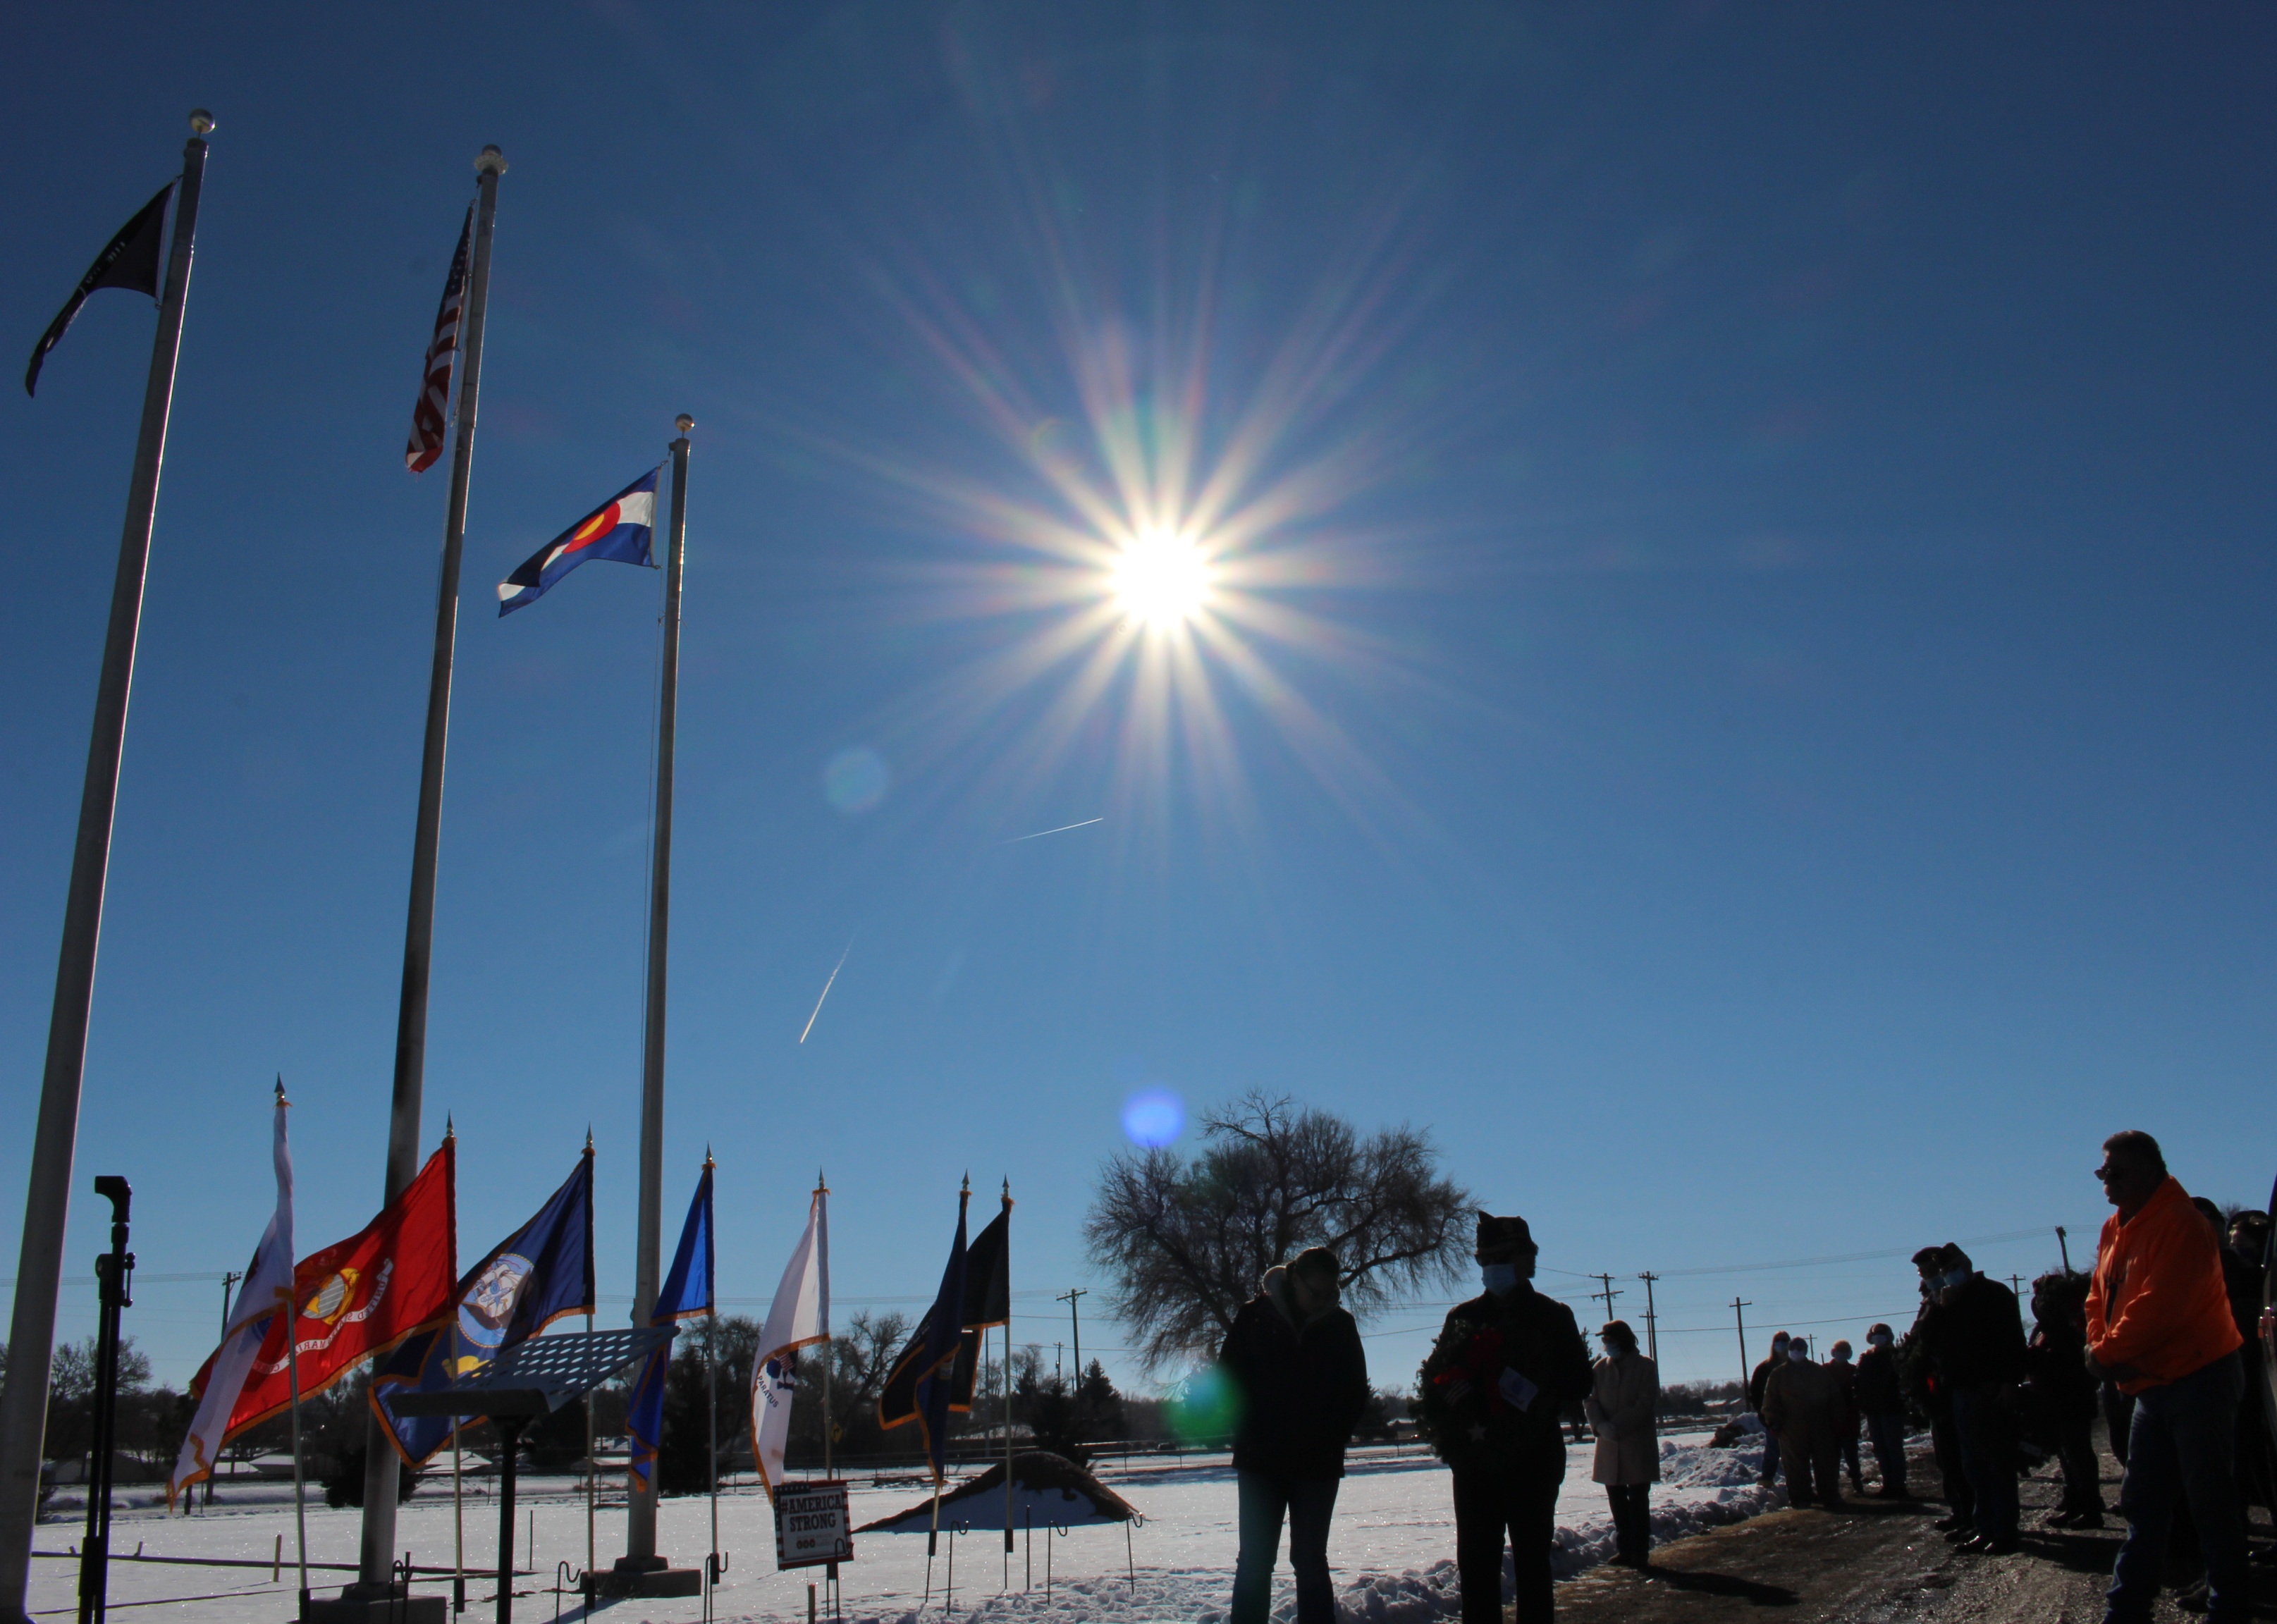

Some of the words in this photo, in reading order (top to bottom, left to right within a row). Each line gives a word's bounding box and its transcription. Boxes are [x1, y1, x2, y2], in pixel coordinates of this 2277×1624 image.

[757, 1375, 779, 1408] PARATUS
[780, 1494, 843, 1515] #AMERICA
[790, 1512, 836, 1532] STRONG
